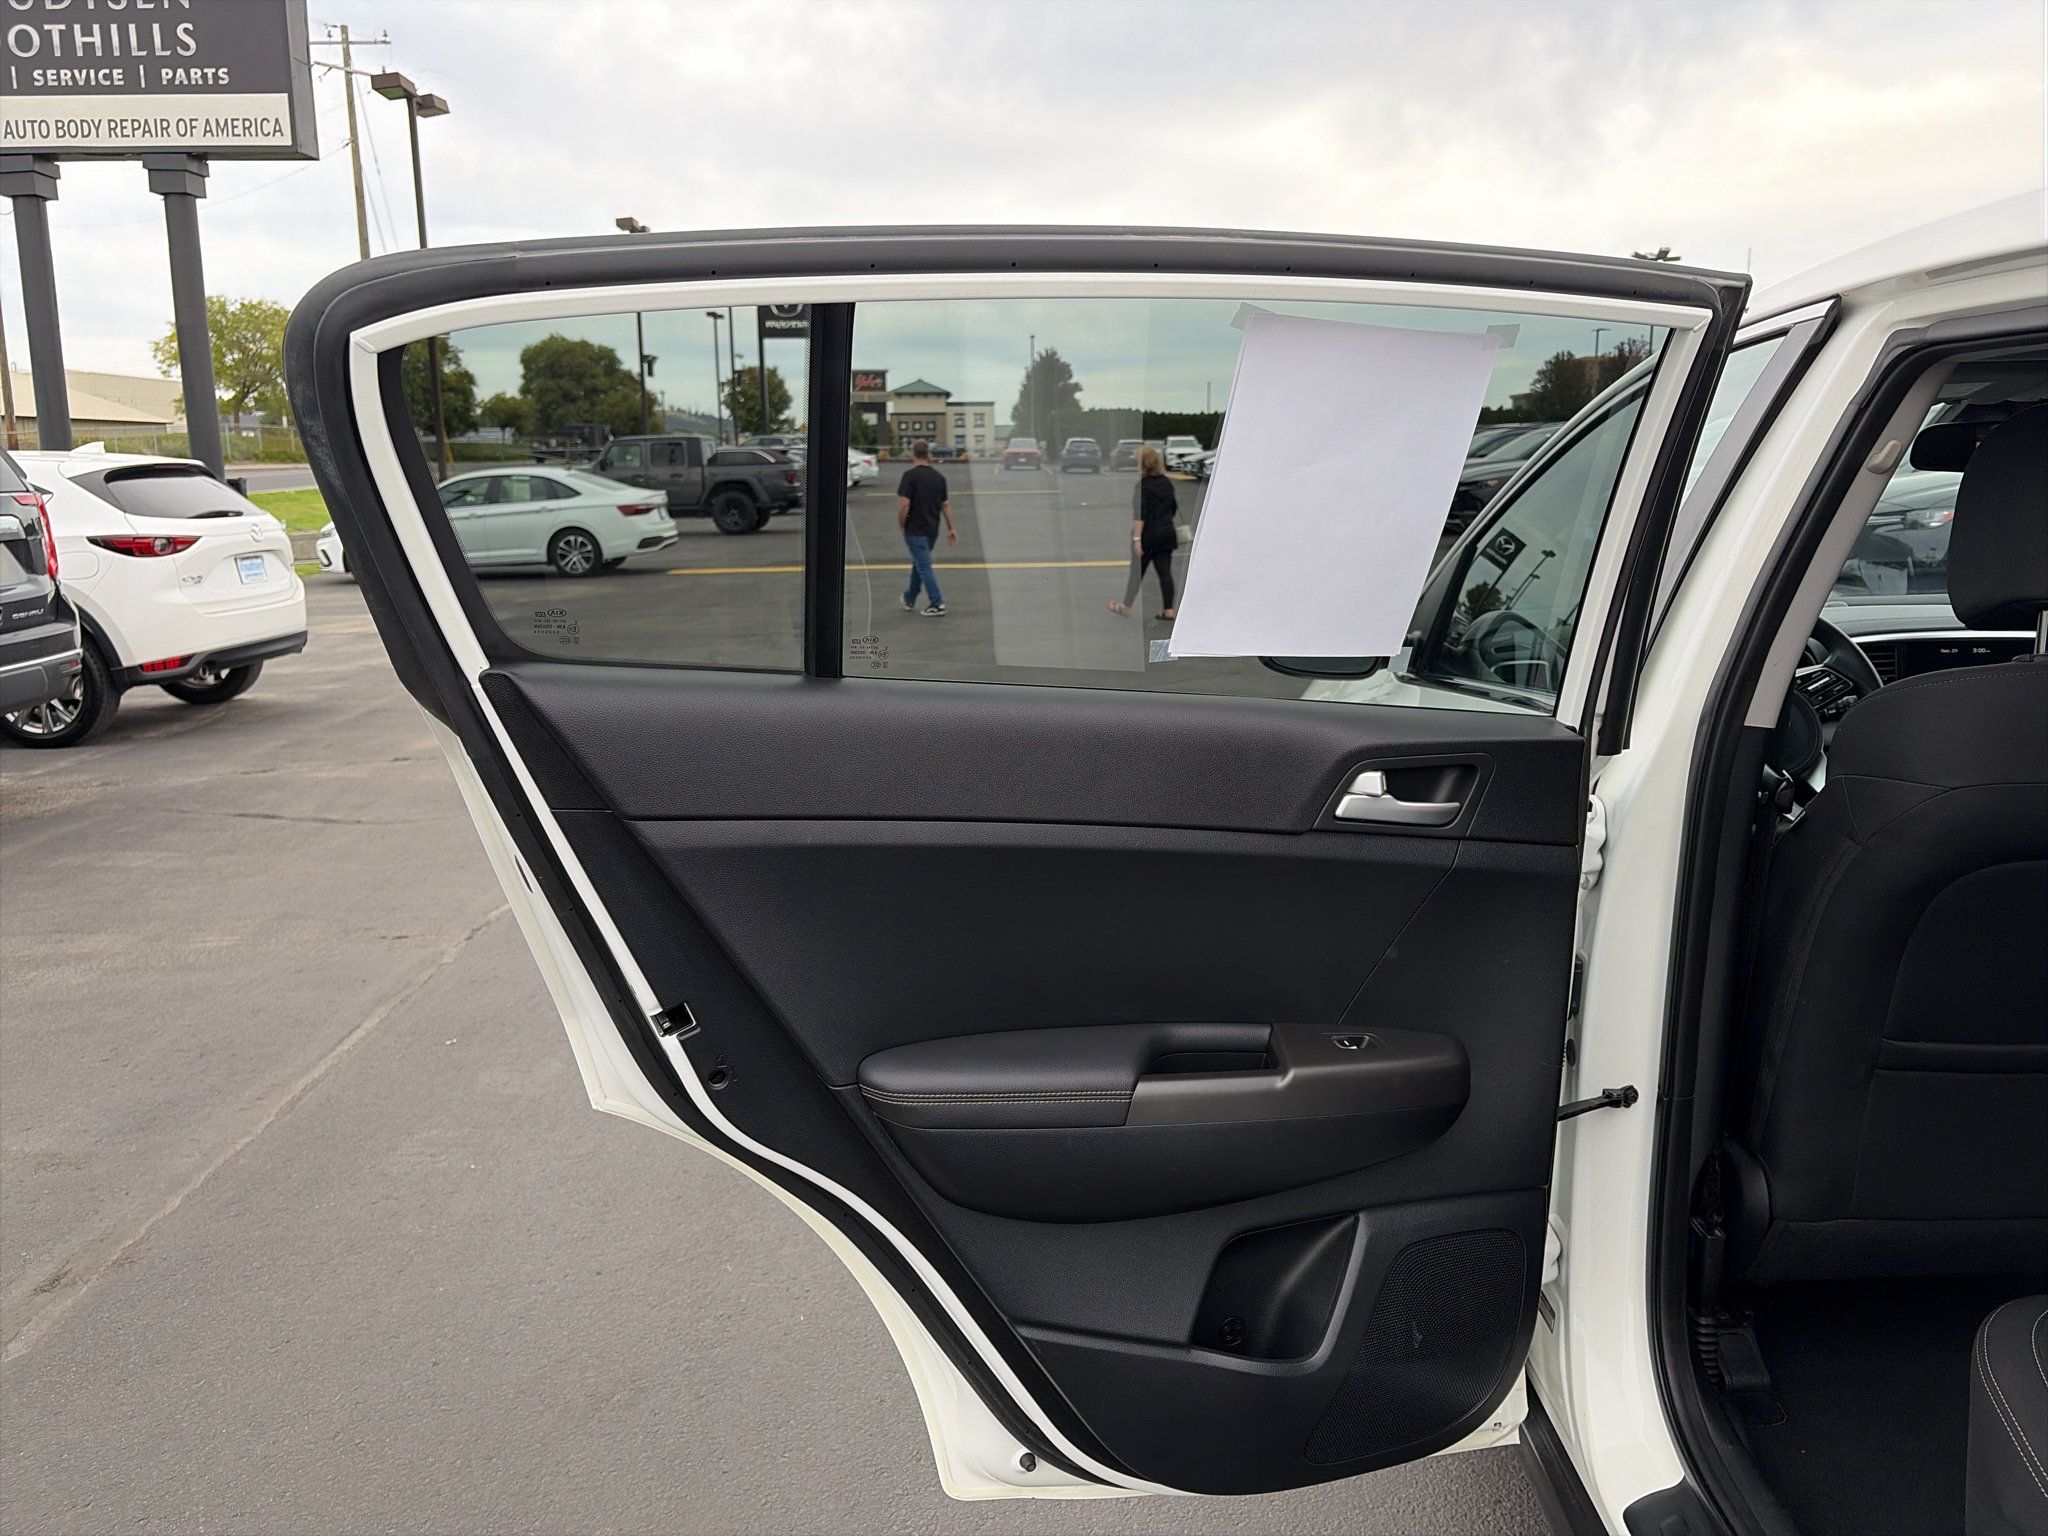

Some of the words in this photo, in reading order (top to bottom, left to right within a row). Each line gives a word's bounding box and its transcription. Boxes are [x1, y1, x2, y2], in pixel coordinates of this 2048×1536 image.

[0, 22, 198, 58] OTHILLS
[32, 68, 126, 87] SERVICE
[161, 67, 230, 85] PARTS
[3, 118, 51, 140] AUTO
[54, 118, 103, 139] BODY
[107, 118, 172, 139] REPAIR
[176, 117, 200, 138] OF
[202, 117, 284, 138] AMERICA
